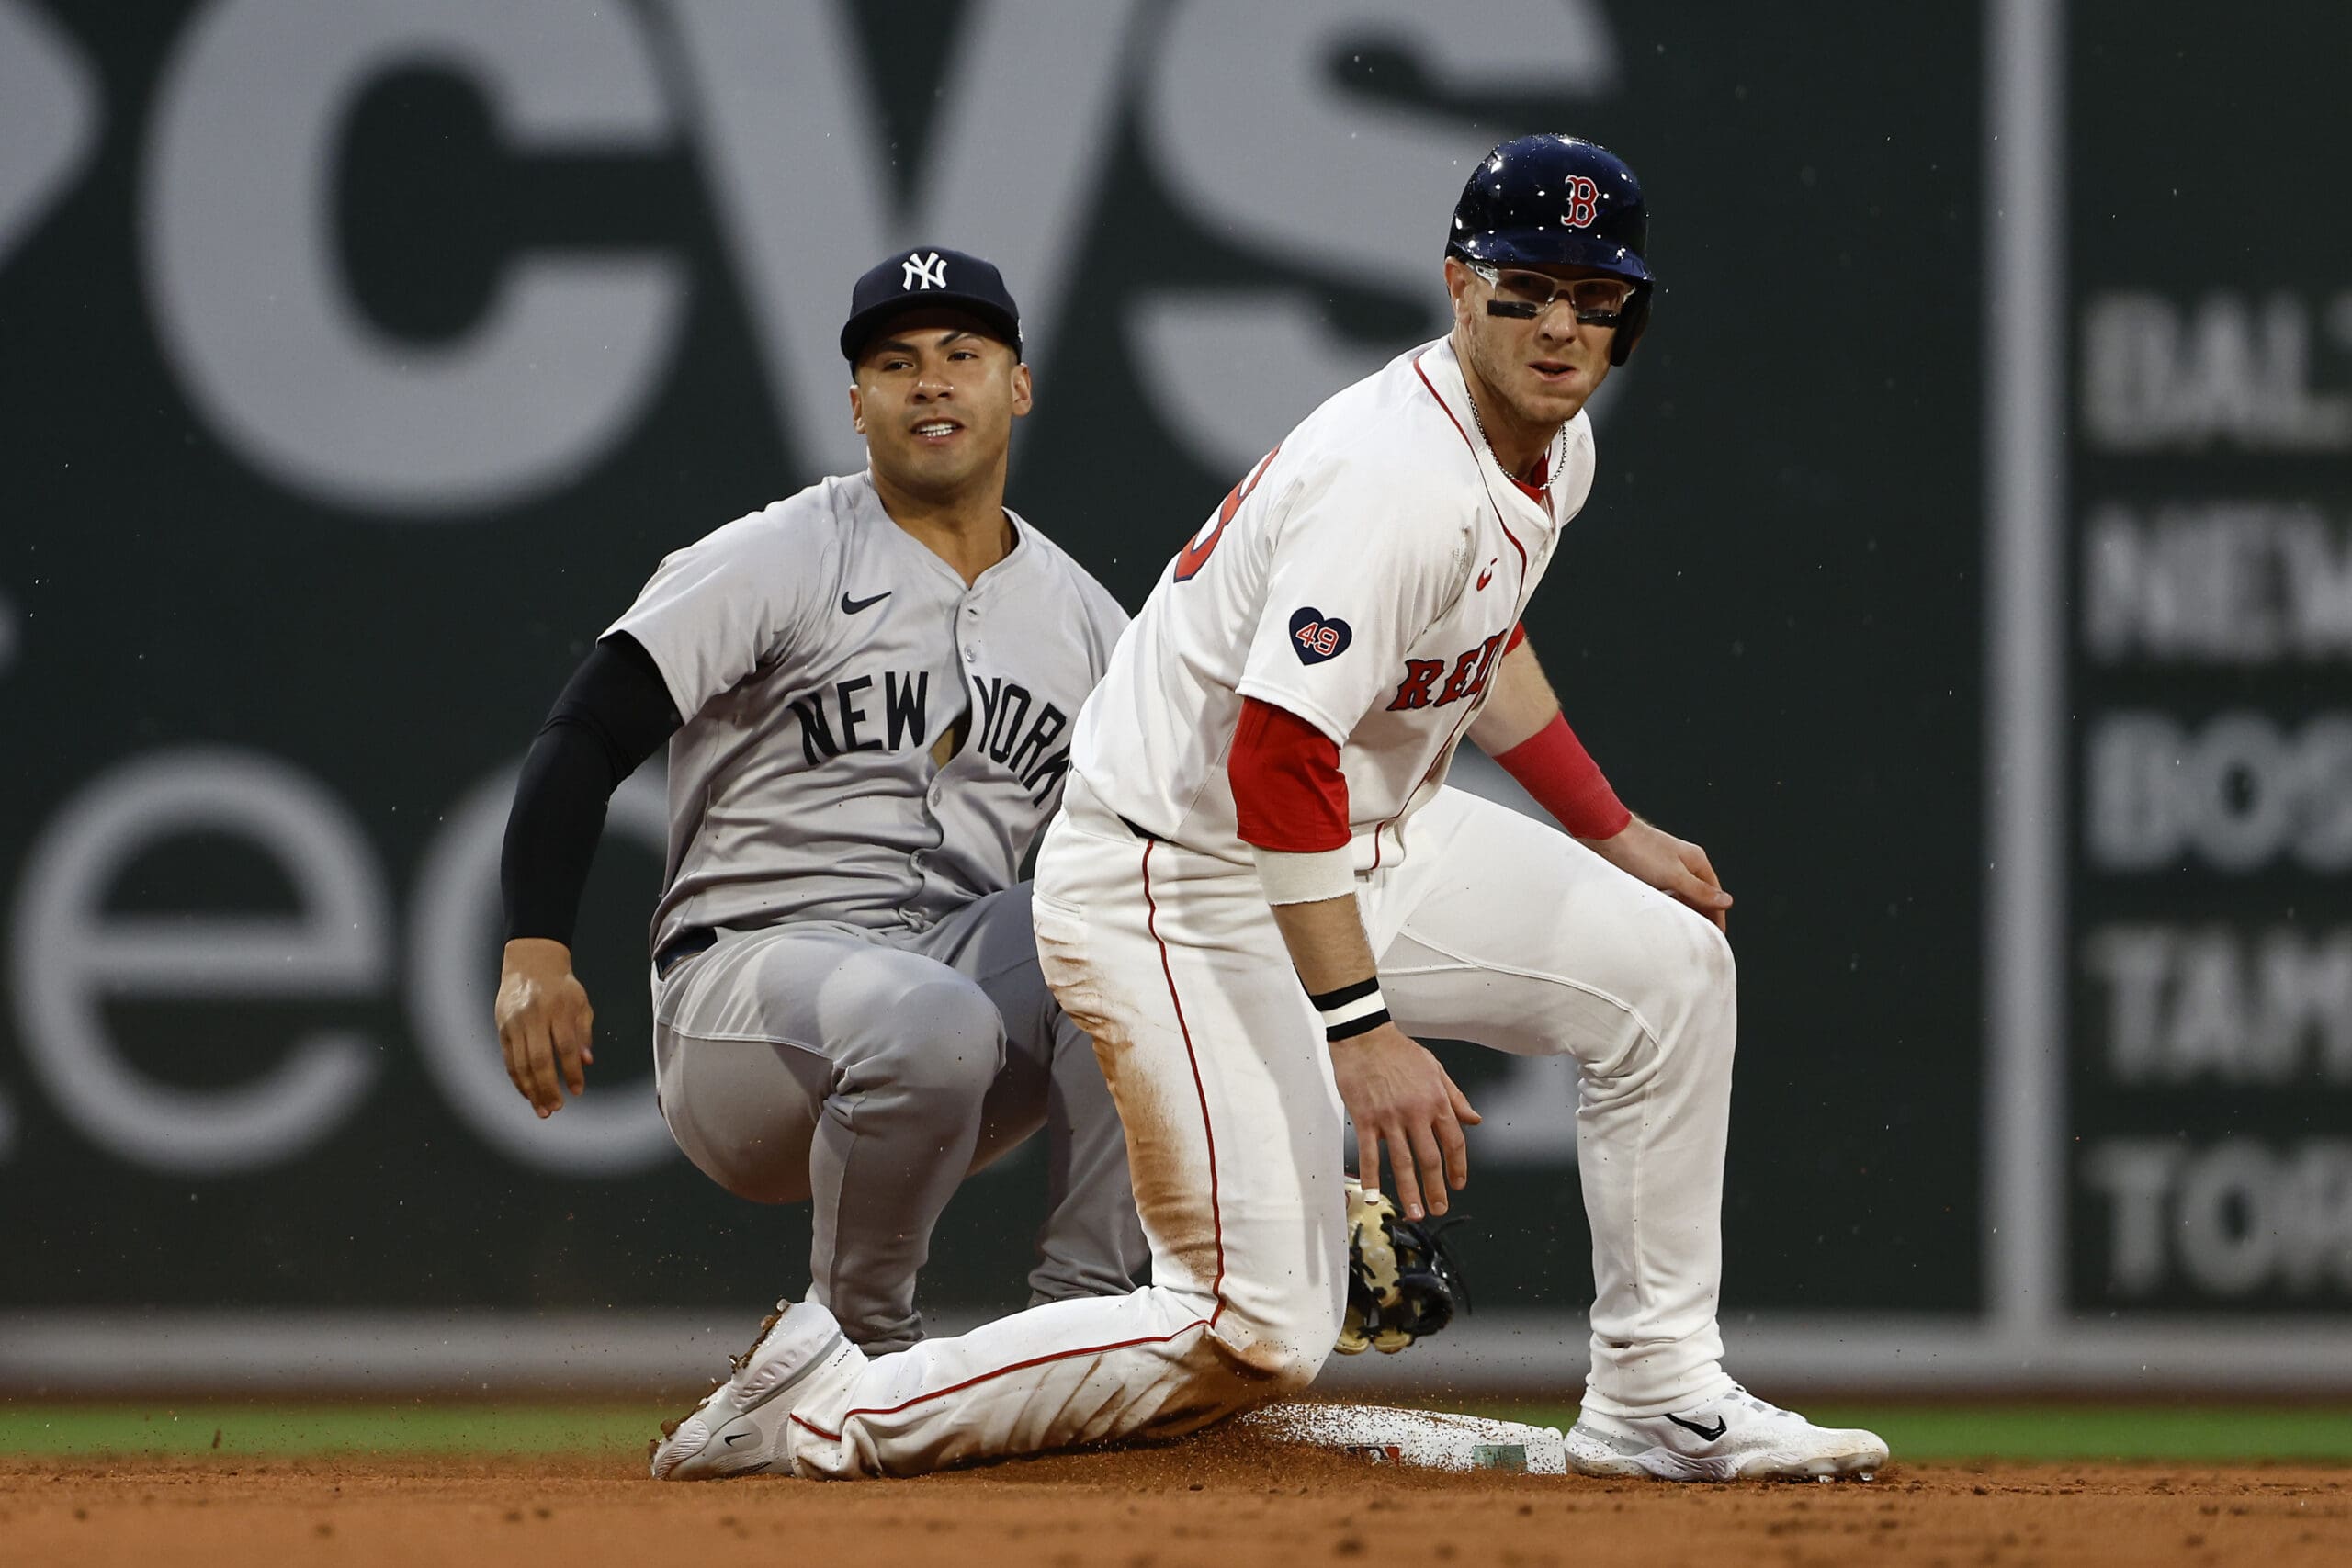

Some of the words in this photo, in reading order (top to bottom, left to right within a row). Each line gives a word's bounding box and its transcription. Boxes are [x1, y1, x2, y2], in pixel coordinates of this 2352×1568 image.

[1560, 174, 1600, 228] B
[901, 252, 947, 290] NY
[2082, 296, 2352, 446] BAL
[1295, 621, 1340, 656] 49
[787, 671, 929, 766] NEW
[972, 675, 1071, 808] YORK
